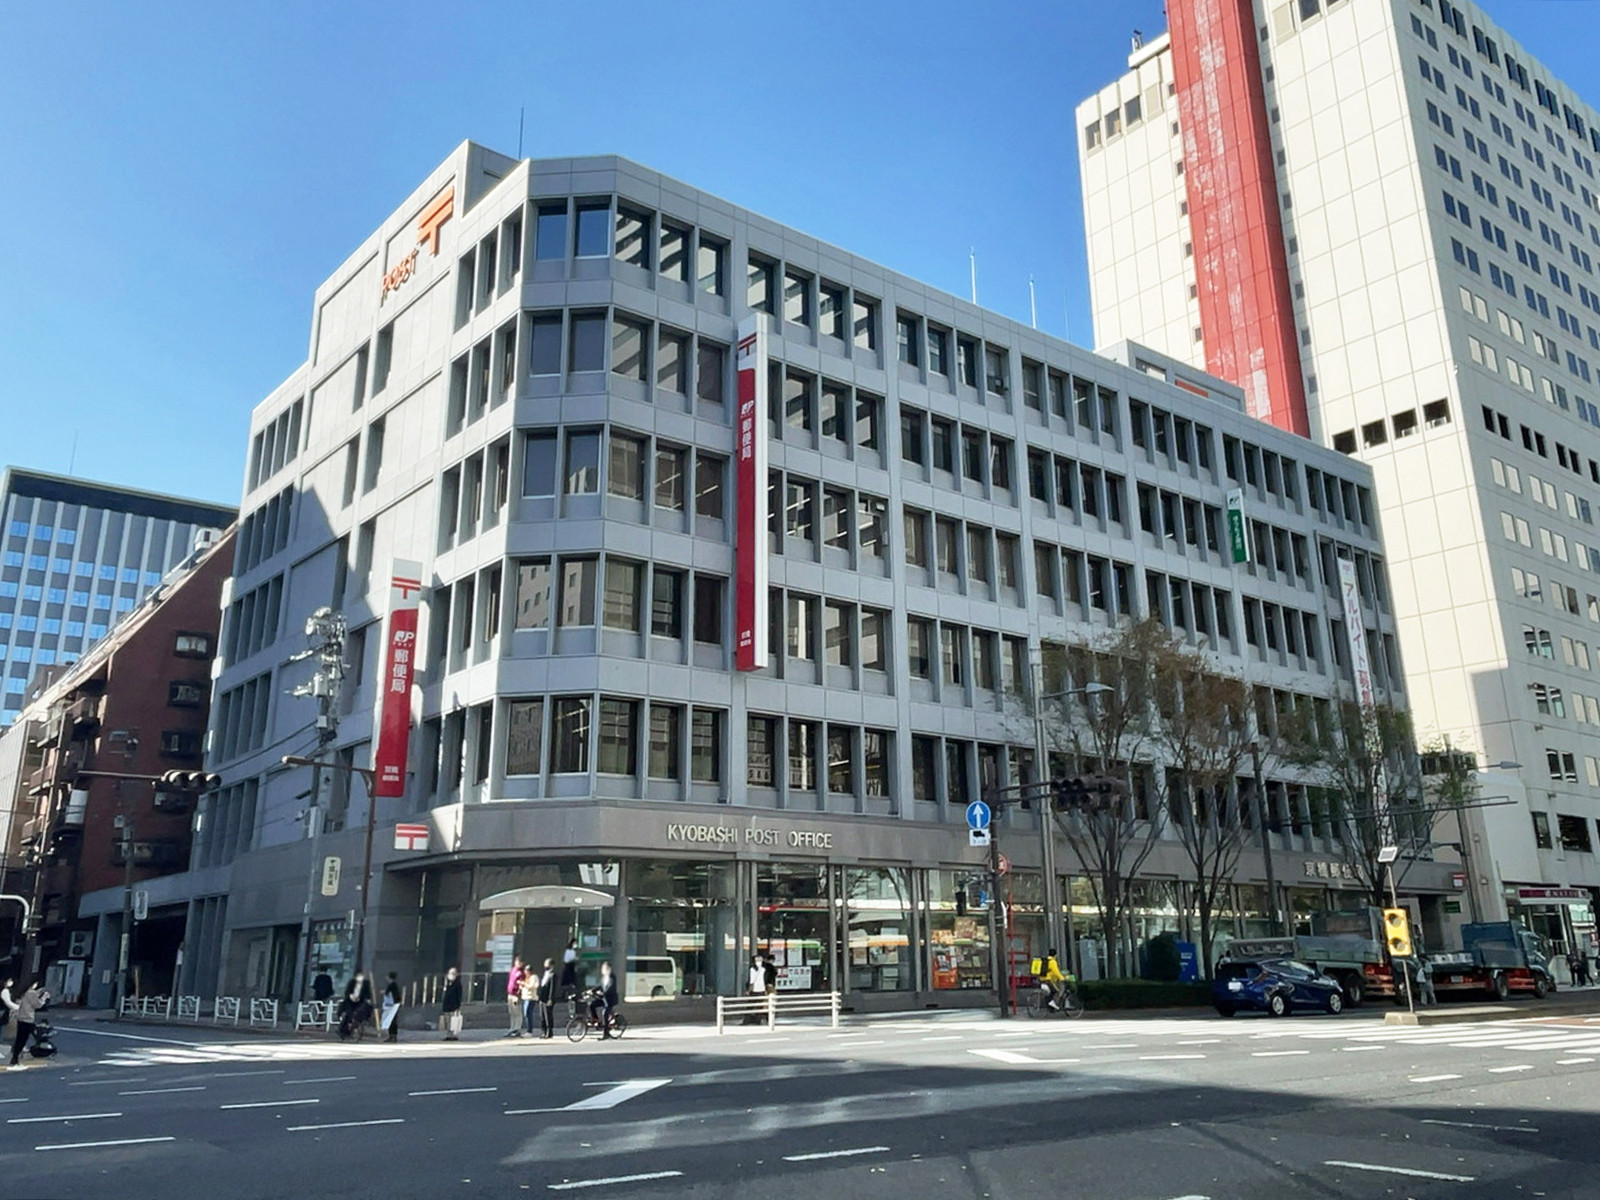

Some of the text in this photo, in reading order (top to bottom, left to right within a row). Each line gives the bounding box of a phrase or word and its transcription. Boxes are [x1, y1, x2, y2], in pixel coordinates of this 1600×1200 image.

[391, 649, 409, 693] 郵便局
[667, 824, 832, 849] KYOBASHI POST OFFICE
